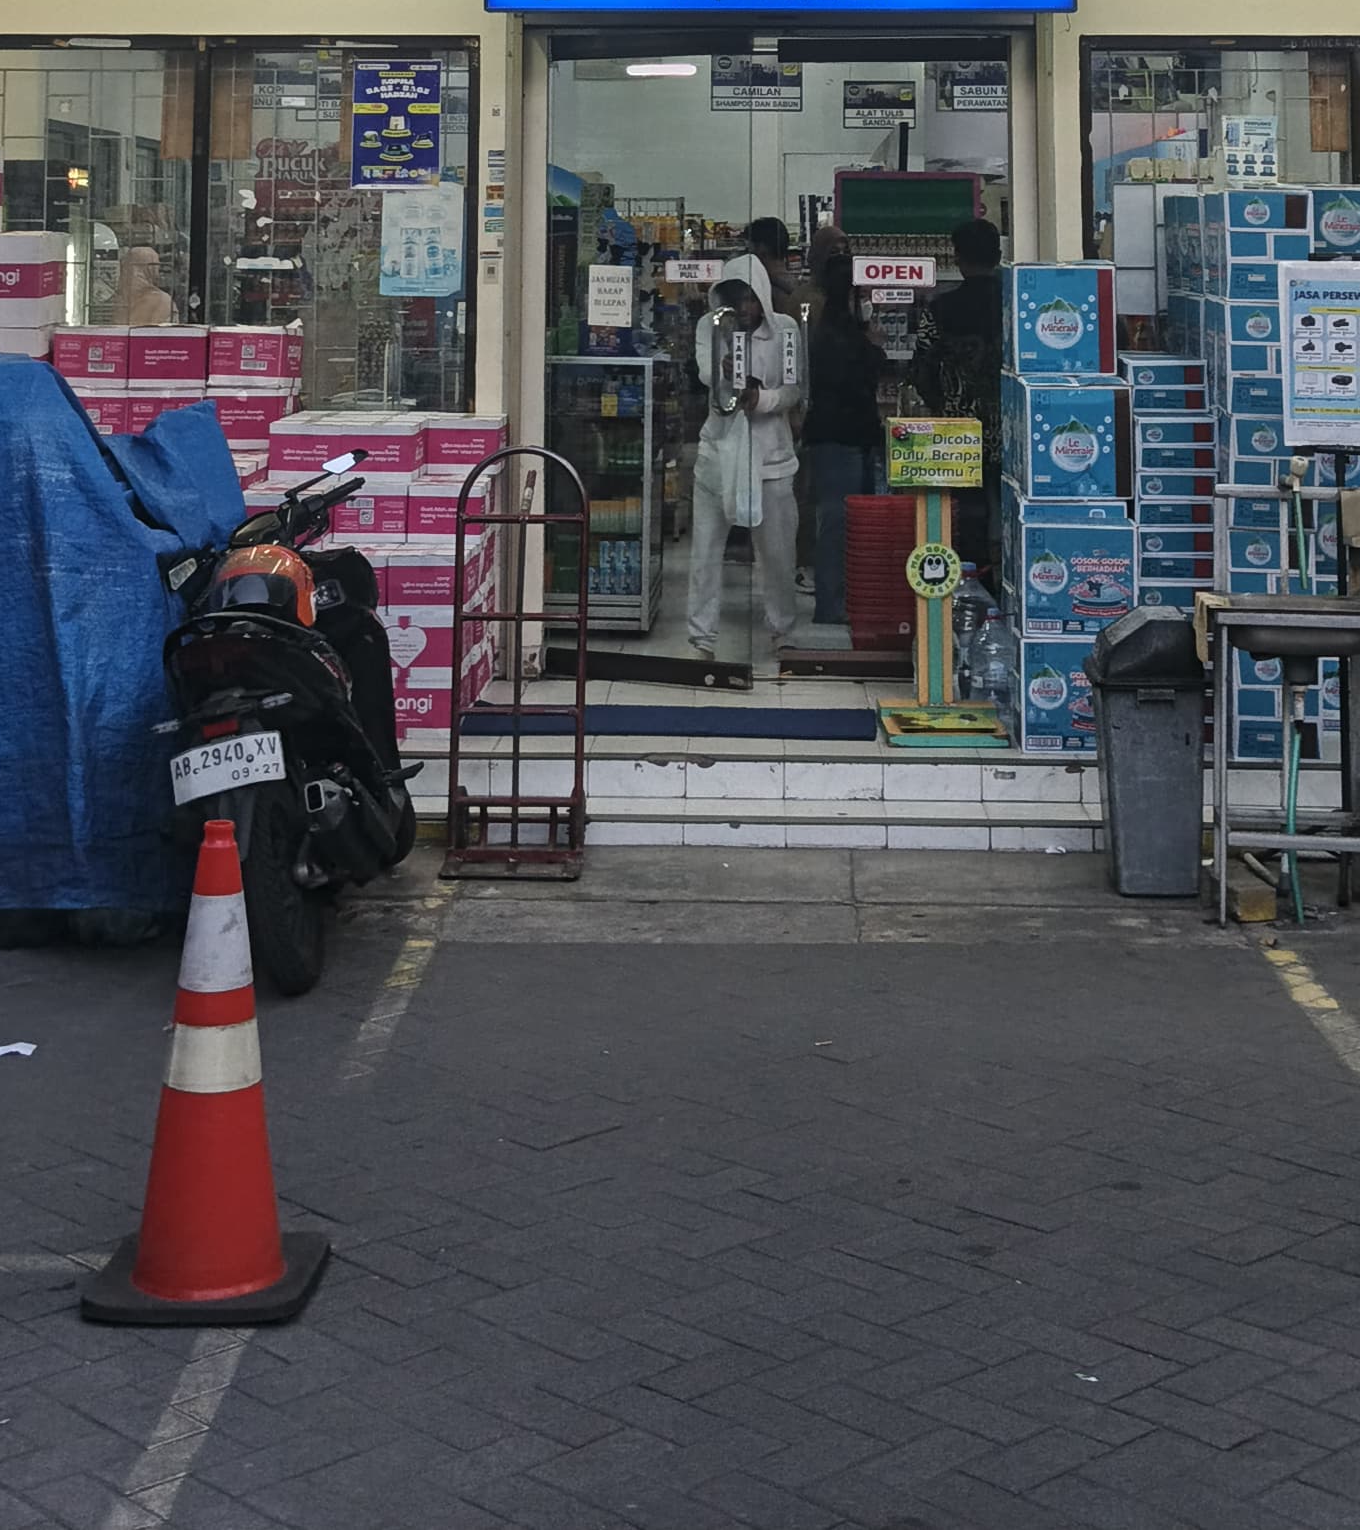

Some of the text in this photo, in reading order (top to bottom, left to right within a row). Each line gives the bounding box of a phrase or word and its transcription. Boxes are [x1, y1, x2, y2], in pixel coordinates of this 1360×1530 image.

[258, 85, 285, 95] KOPI
[732, 87, 782, 97] CAMILAN
[959, 86, 998, 96] SABUN
[679, 271, 698, 279] PULL
[865, 264, 924, 280] OPEN
[1293, 291, 1320, 301] JASA
[1053, 316, 1065, 325] Le
[1040, 322, 1080, 334] Minerale
[1068, 438, 1080, 447] Le
[891, 449, 981, 463] Dulu, Berapa
[1054, 446, 1096, 456] Minerale
[900, 465, 964, 478] Bobotmu
[174, 735, 278, 781] AB 2940 XV
